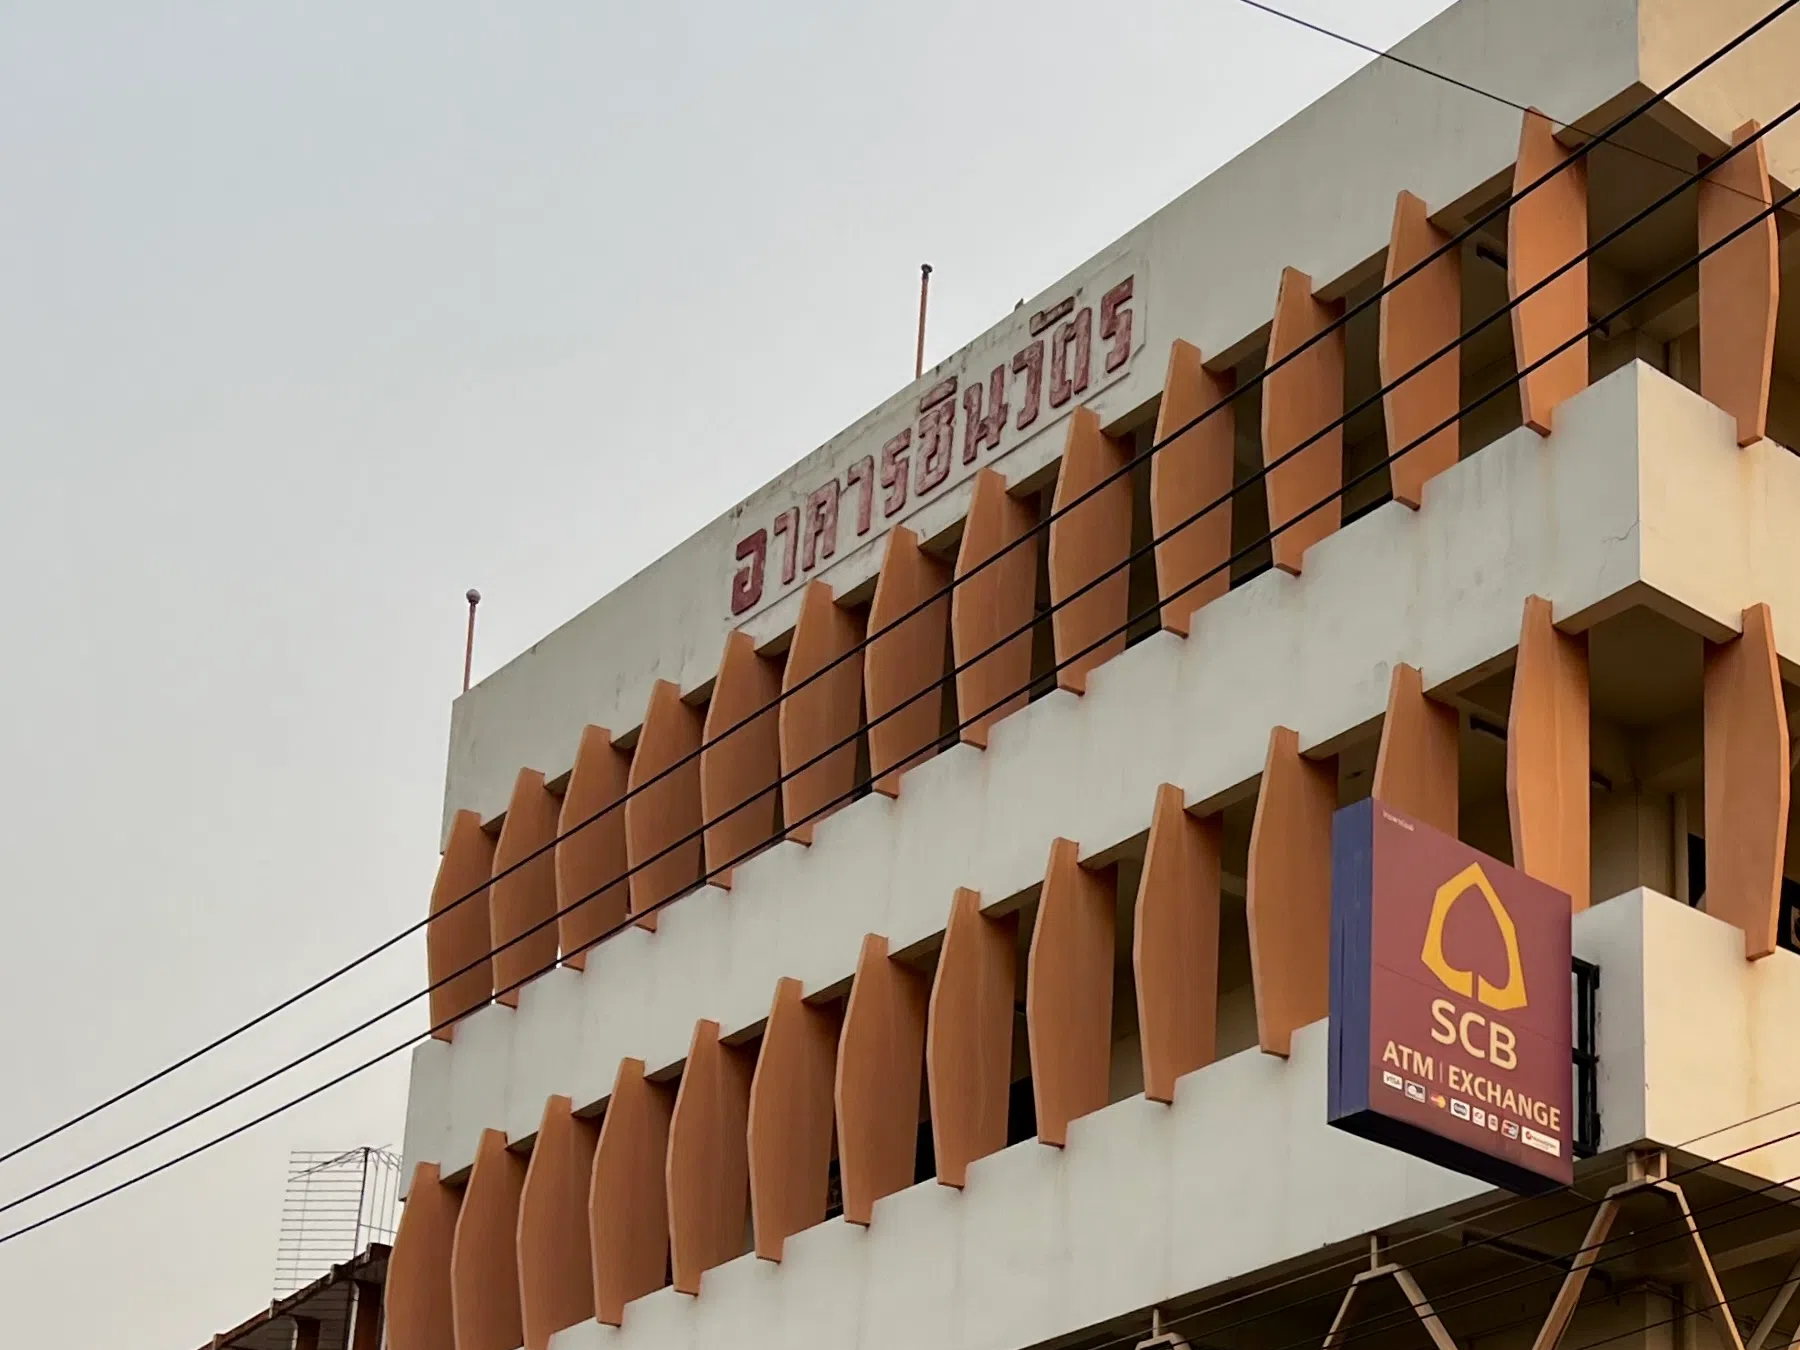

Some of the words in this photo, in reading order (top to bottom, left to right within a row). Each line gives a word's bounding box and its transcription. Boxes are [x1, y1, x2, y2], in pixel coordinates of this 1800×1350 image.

[731, 273, 1136, 617] อาคารชินวัตร
[1430, 998, 1519, 1071] SCB
[1382, 1040, 1434, 1081] ATM
[1448, 1064, 1561, 1132] EXCHANGE
